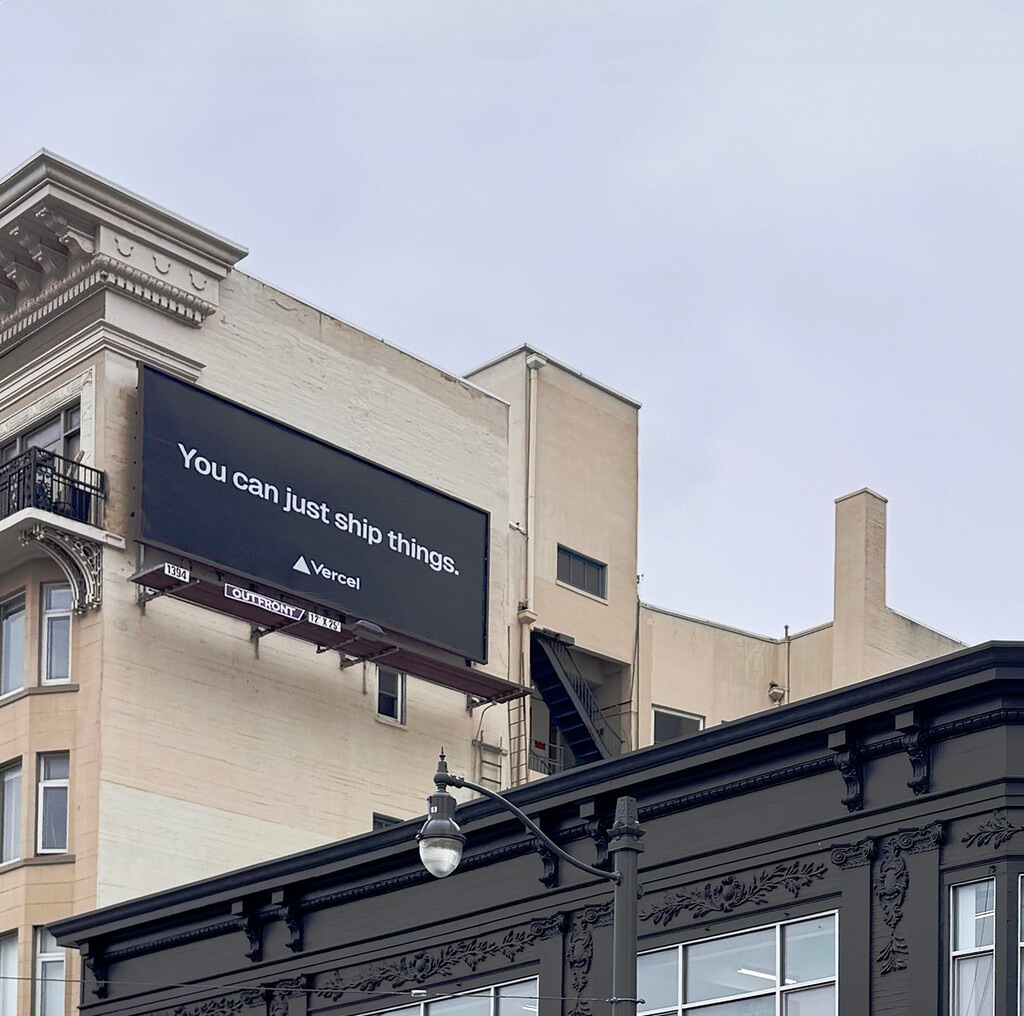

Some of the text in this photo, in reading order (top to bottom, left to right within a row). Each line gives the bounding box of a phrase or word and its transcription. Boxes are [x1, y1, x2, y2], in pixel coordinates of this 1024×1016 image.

[178, 443, 460, 576] You can just ship things.
[167, 564, 187, 581] 1394
[310, 559, 361, 590] Vercel
[232, 588, 296, 617] OUTFRONT
